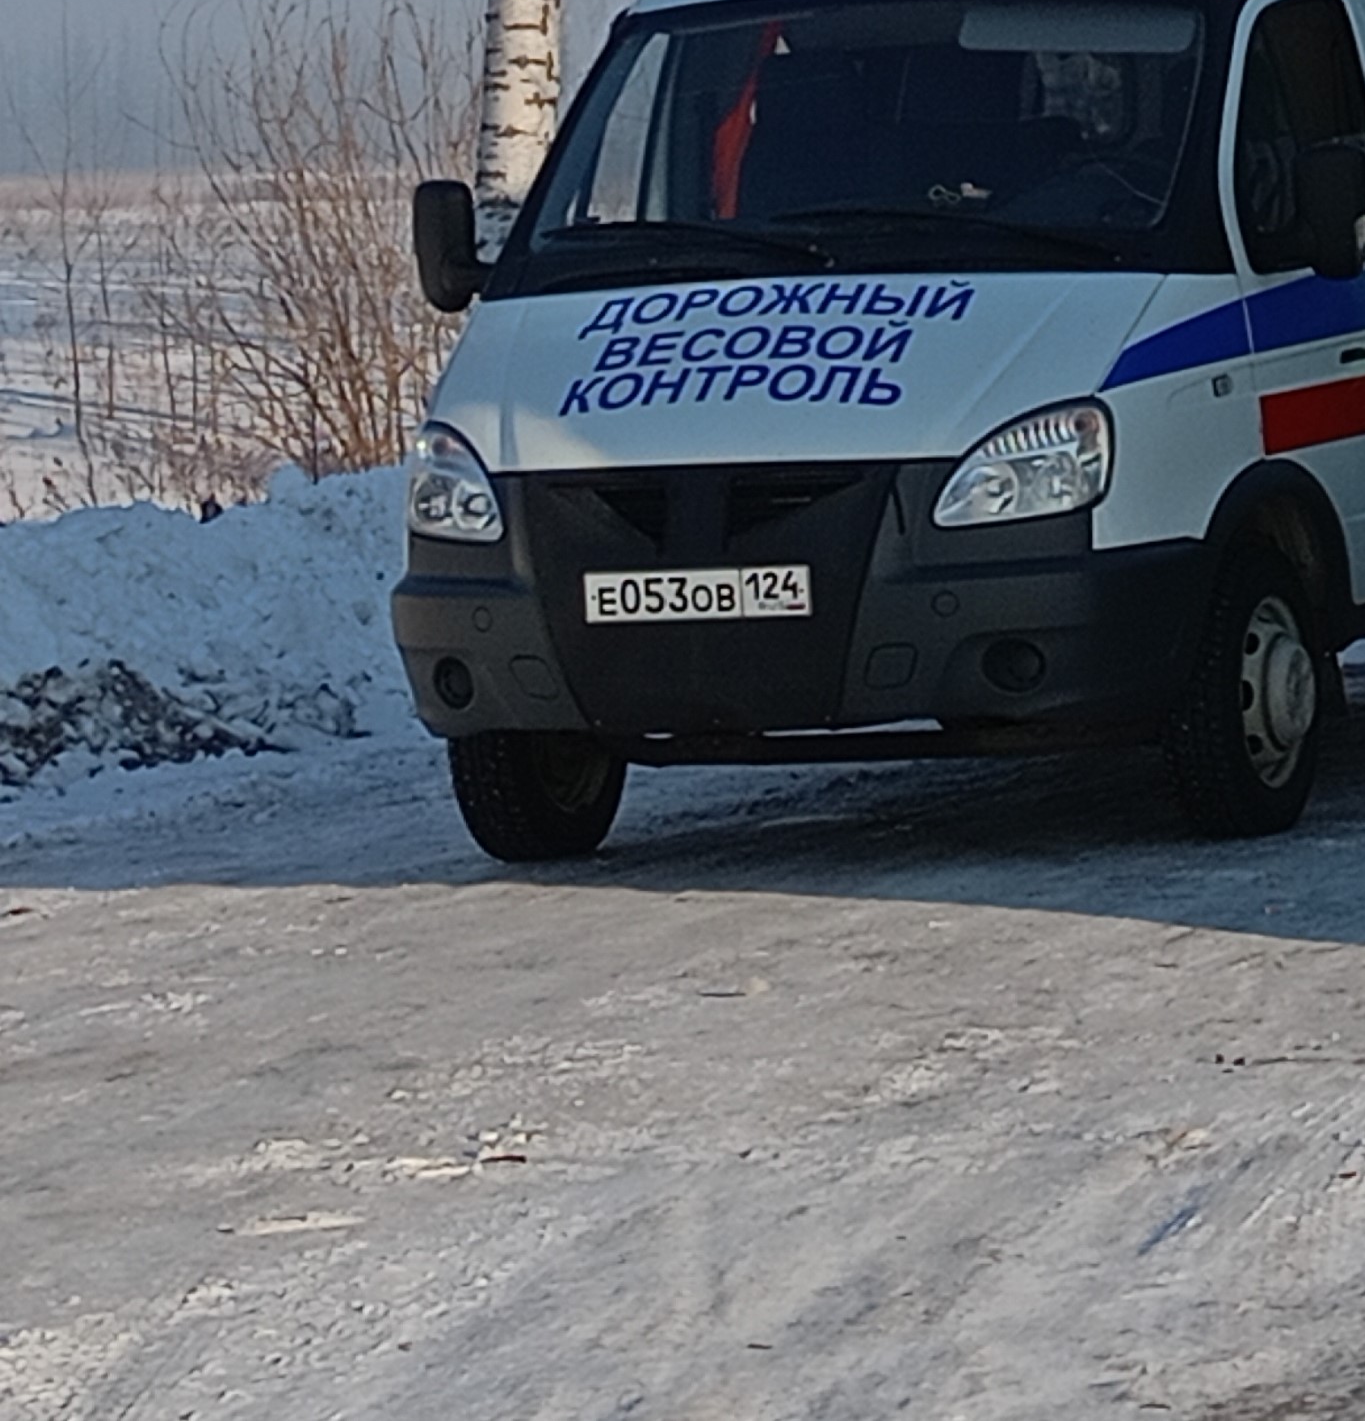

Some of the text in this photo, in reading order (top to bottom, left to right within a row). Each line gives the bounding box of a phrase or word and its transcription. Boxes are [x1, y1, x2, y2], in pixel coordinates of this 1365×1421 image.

[578, 280, 975, 341] ДОРОЖНЫЙ
[593, 320, 913, 372] ВЕСОВОЙ
[558, 365, 902, 416] КОНТРОЛЬ
[598, 570, 798, 616] Е053ОВ 124
